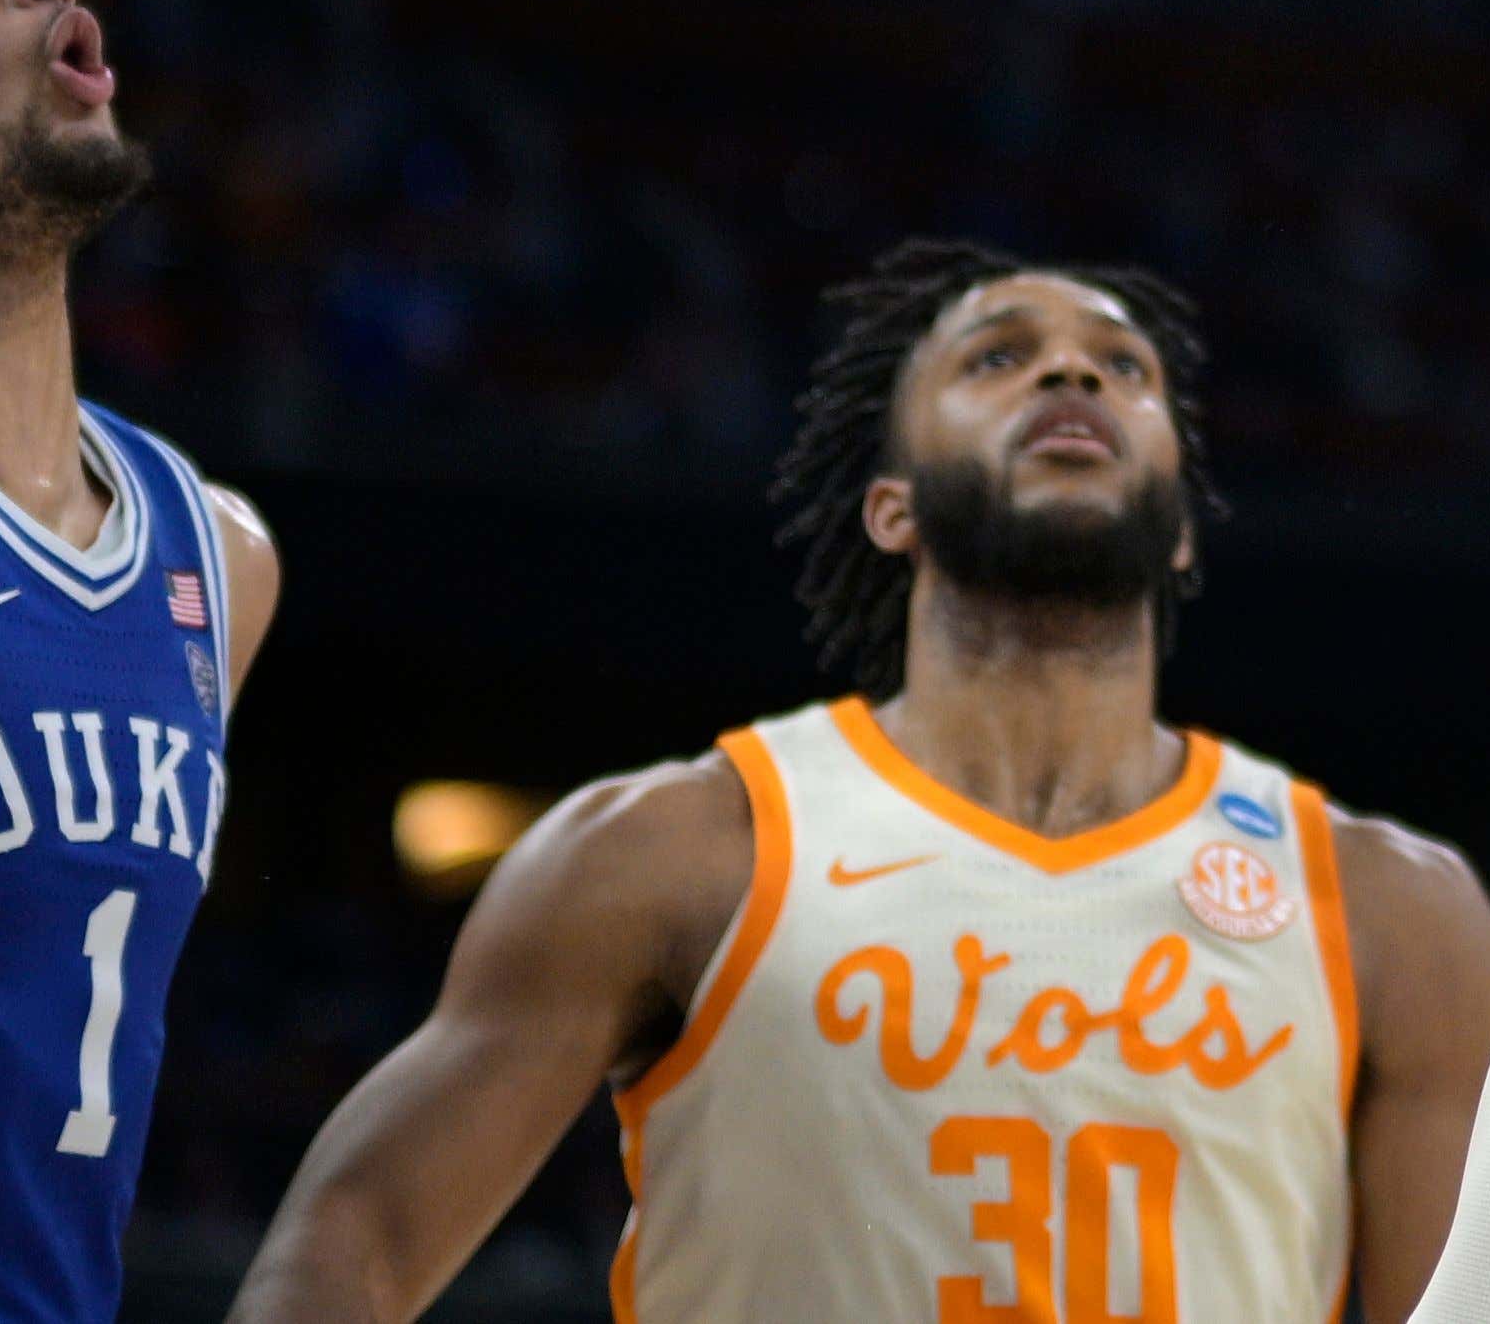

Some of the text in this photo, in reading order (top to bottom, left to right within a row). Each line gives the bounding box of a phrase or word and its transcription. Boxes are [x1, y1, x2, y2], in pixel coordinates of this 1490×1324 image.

[1198, 848, 1277, 912] SEC
[55, 890, 137, 1158] 1
[815, 932, 1295, 1091] Vols
[929, 1115, 1180, 1324] 30
